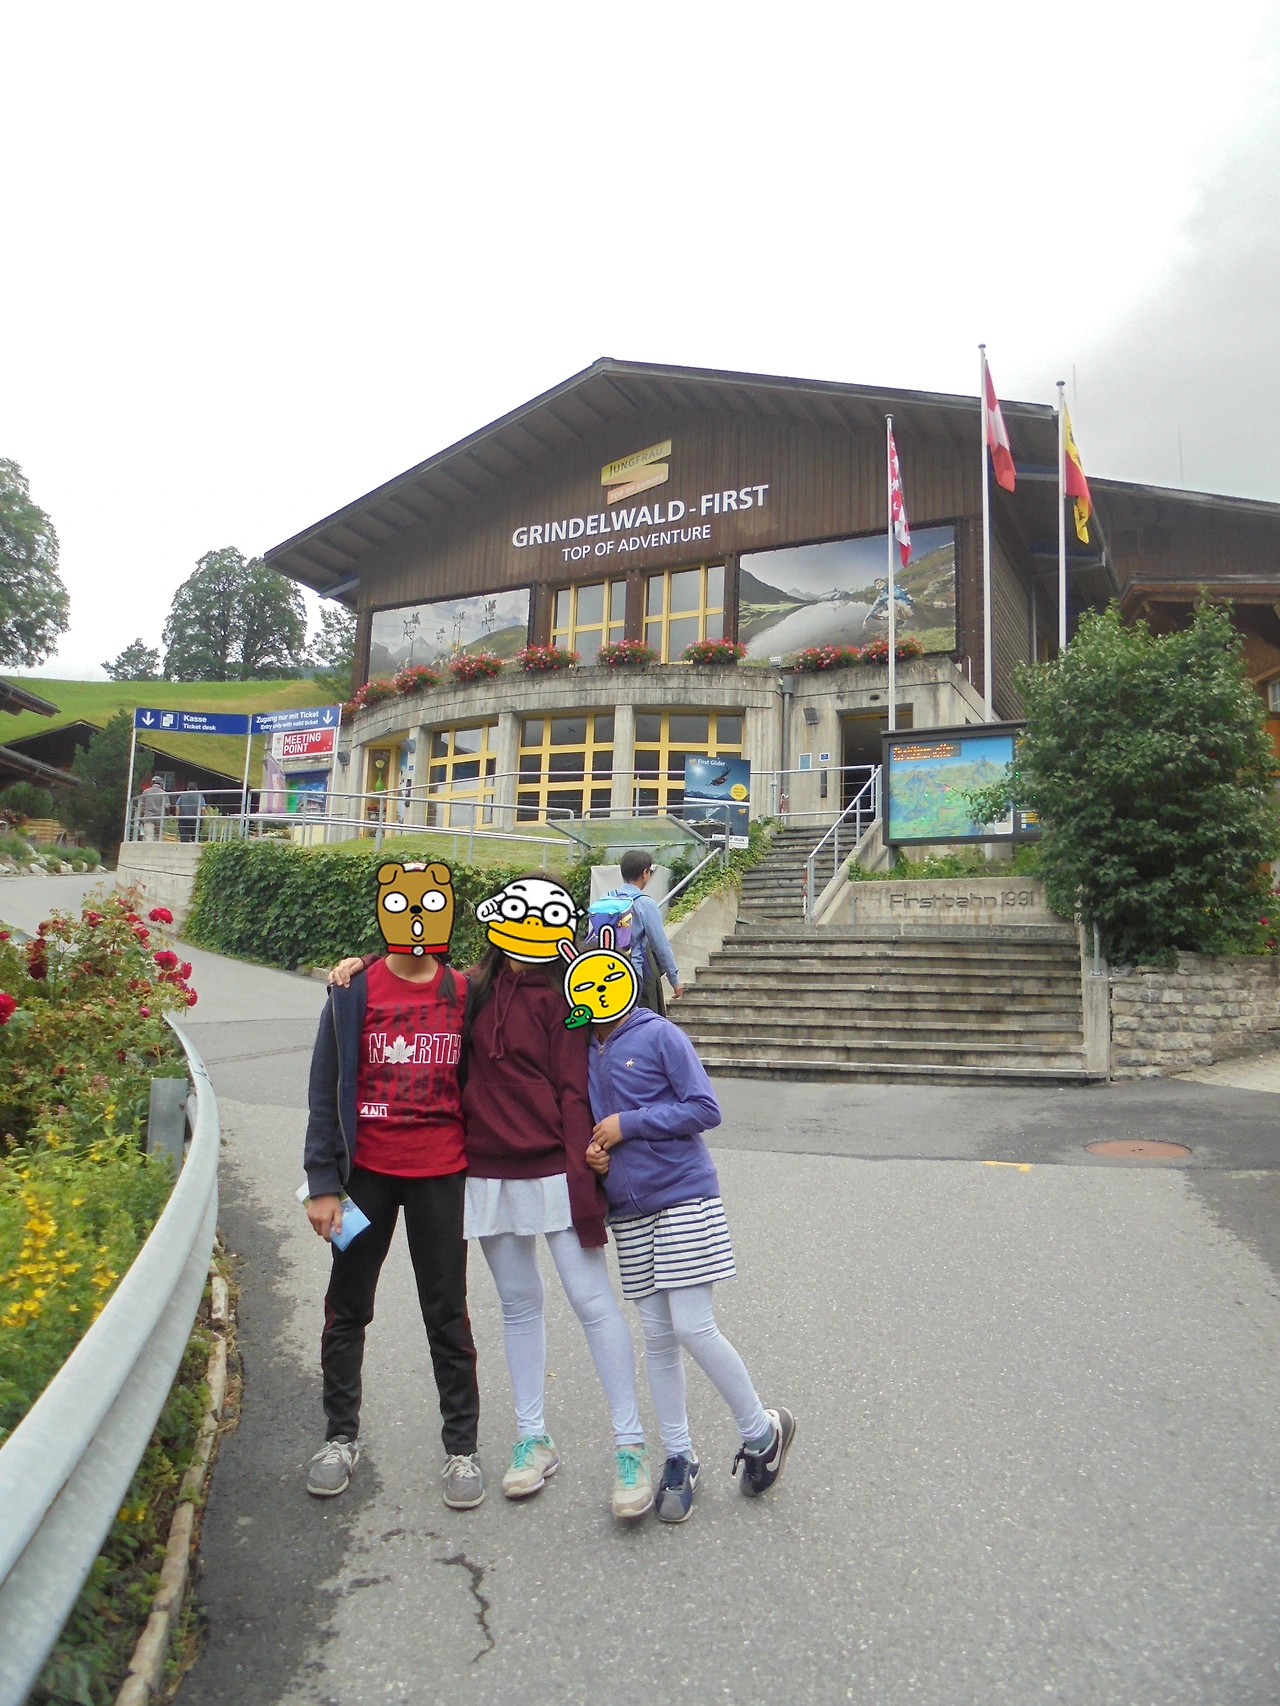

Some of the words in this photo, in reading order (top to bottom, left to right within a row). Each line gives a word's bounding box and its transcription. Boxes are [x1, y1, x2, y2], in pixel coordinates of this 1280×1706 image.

[609, 447, 663, 477] JUNGFRAU
[610, 489, 625, 500] TOP
[562, 544, 591, 562] TOP
[595, 540, 615, 557] OF
[617, 524, 711, 553] ADVENTURE
[183, 714, 207, 723] Kasse
[256, 716, 278, 724] Zugang
[284, 732, 321, 745] MEETING
[283, 743, 309, 754] POINT
[890, 892, 997, 909] Firstbahn
[1001, 890, 1034, 909] 1991
